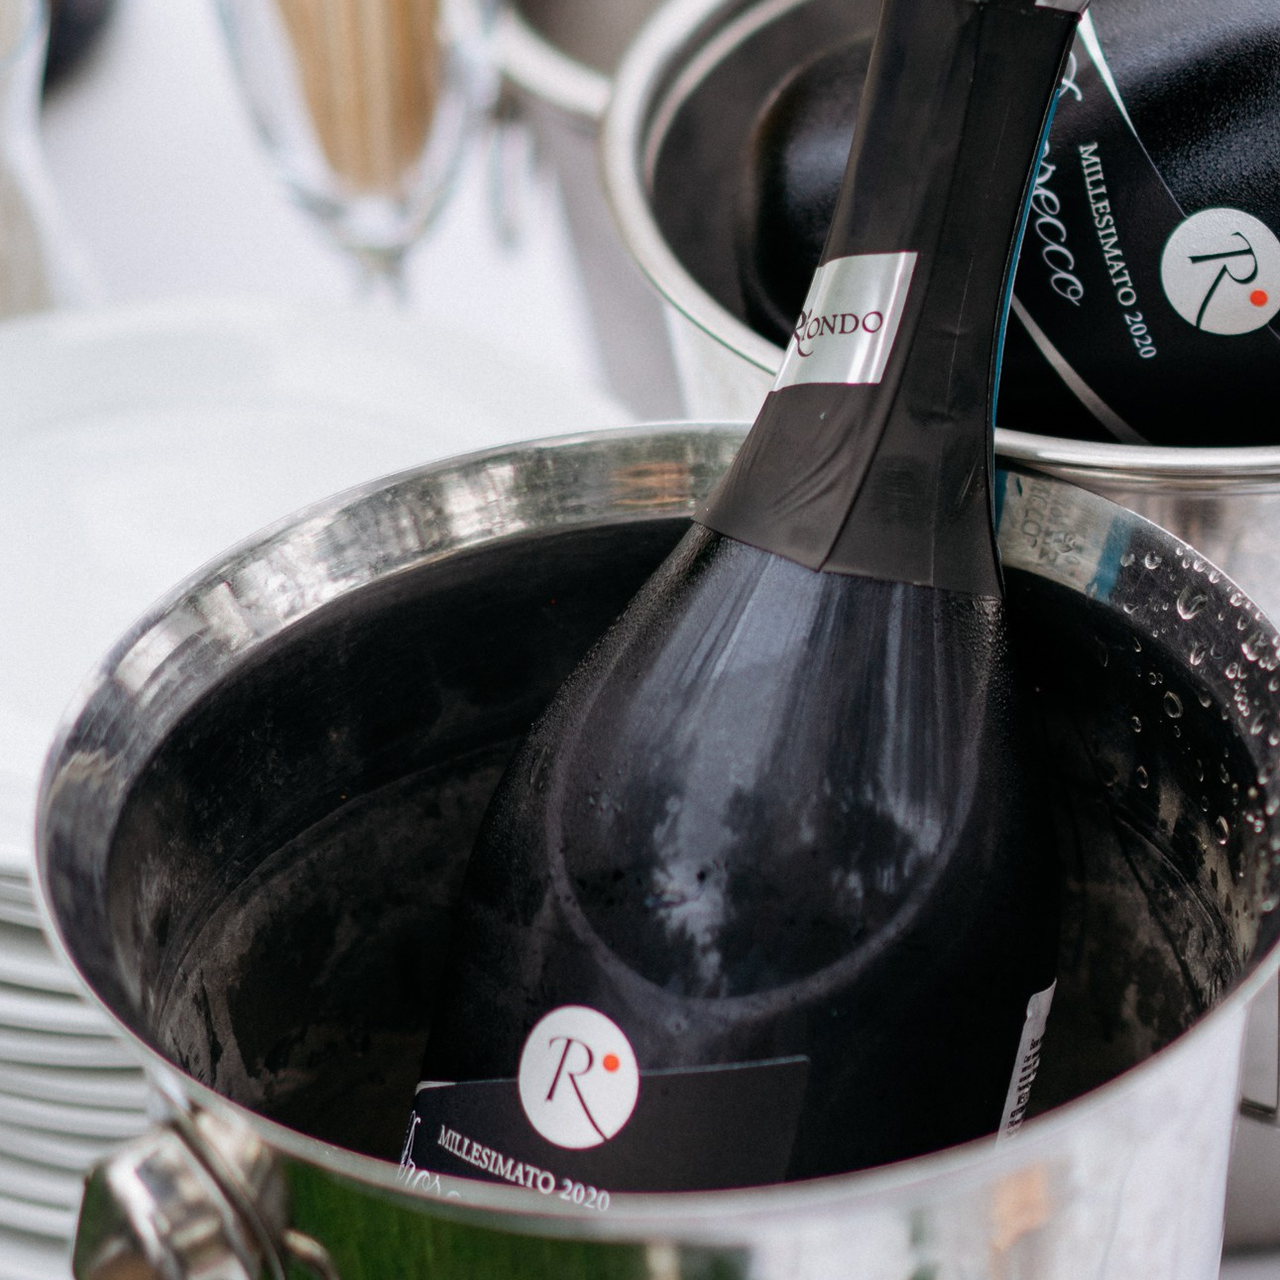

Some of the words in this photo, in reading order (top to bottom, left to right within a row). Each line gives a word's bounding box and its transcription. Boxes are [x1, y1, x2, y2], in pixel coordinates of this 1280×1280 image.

[1078, 142, 1137, 308] MILLESIMATO
[1123, 311, 1157, 360] 2020
[437, 1124, 556, 1195] MILLESIMATO
[559, 1178, 611, 1213] 2020
